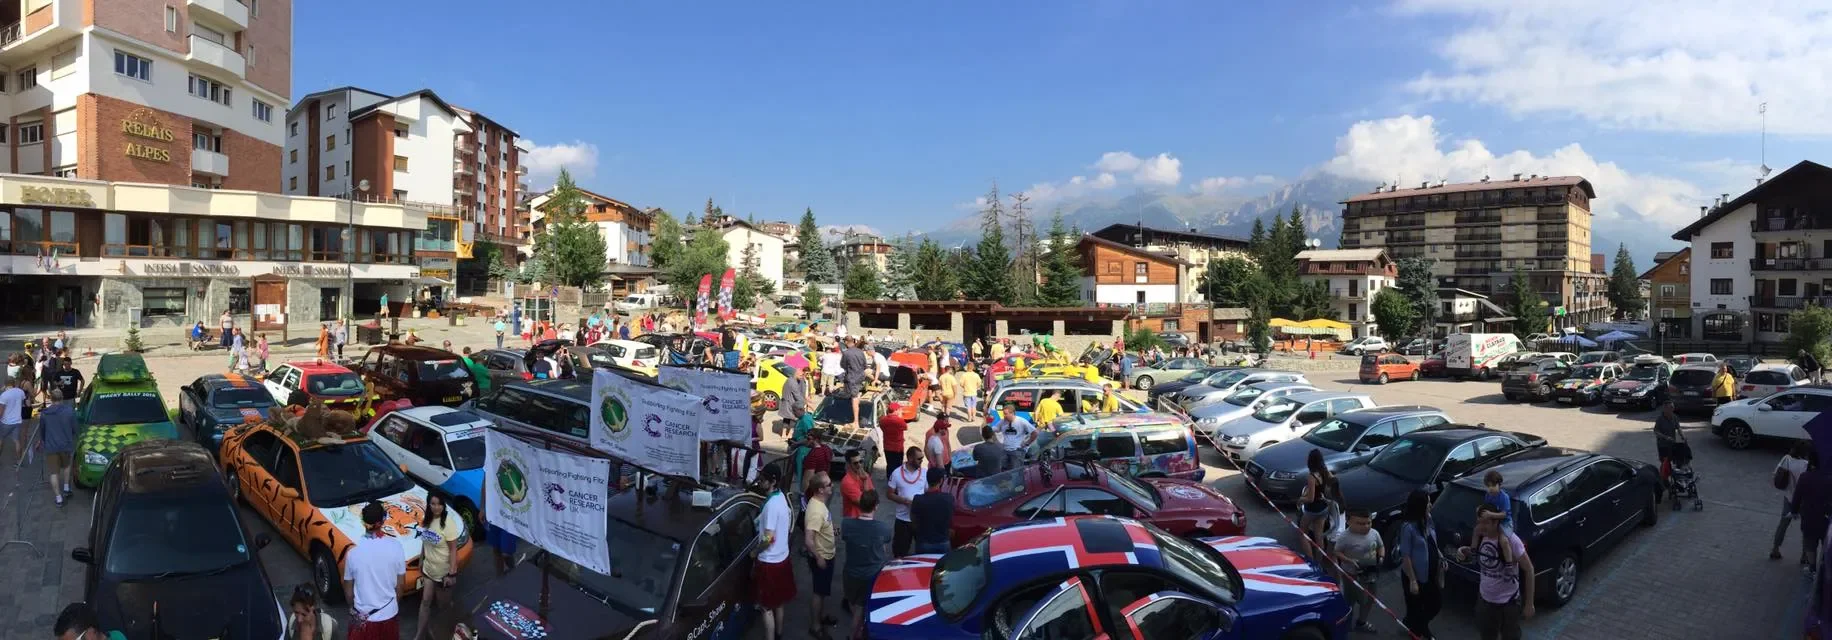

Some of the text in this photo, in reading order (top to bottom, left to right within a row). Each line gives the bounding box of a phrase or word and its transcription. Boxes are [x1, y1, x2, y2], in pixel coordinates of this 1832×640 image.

[121, 119, 174, 142] RELAIS
[125, 143, 170, 162] ALPES
[20, 185, 94, 207] HOTEL
[144, 263, 239, 276] INTESA SANPAOLO
[273, 265, 301, 275] INTESA
[641, 398, 697, 417] Supporting Fighting Fitz
[664, 420, 691, 431] CANCER
[664, 427, 698, 438] RESEARCH
[539, 465, 605, 485] Supporting Fighting Fitz
[568, 490, 599, 503] CANCER
[569, 498, 605, 513] RESEARCH
